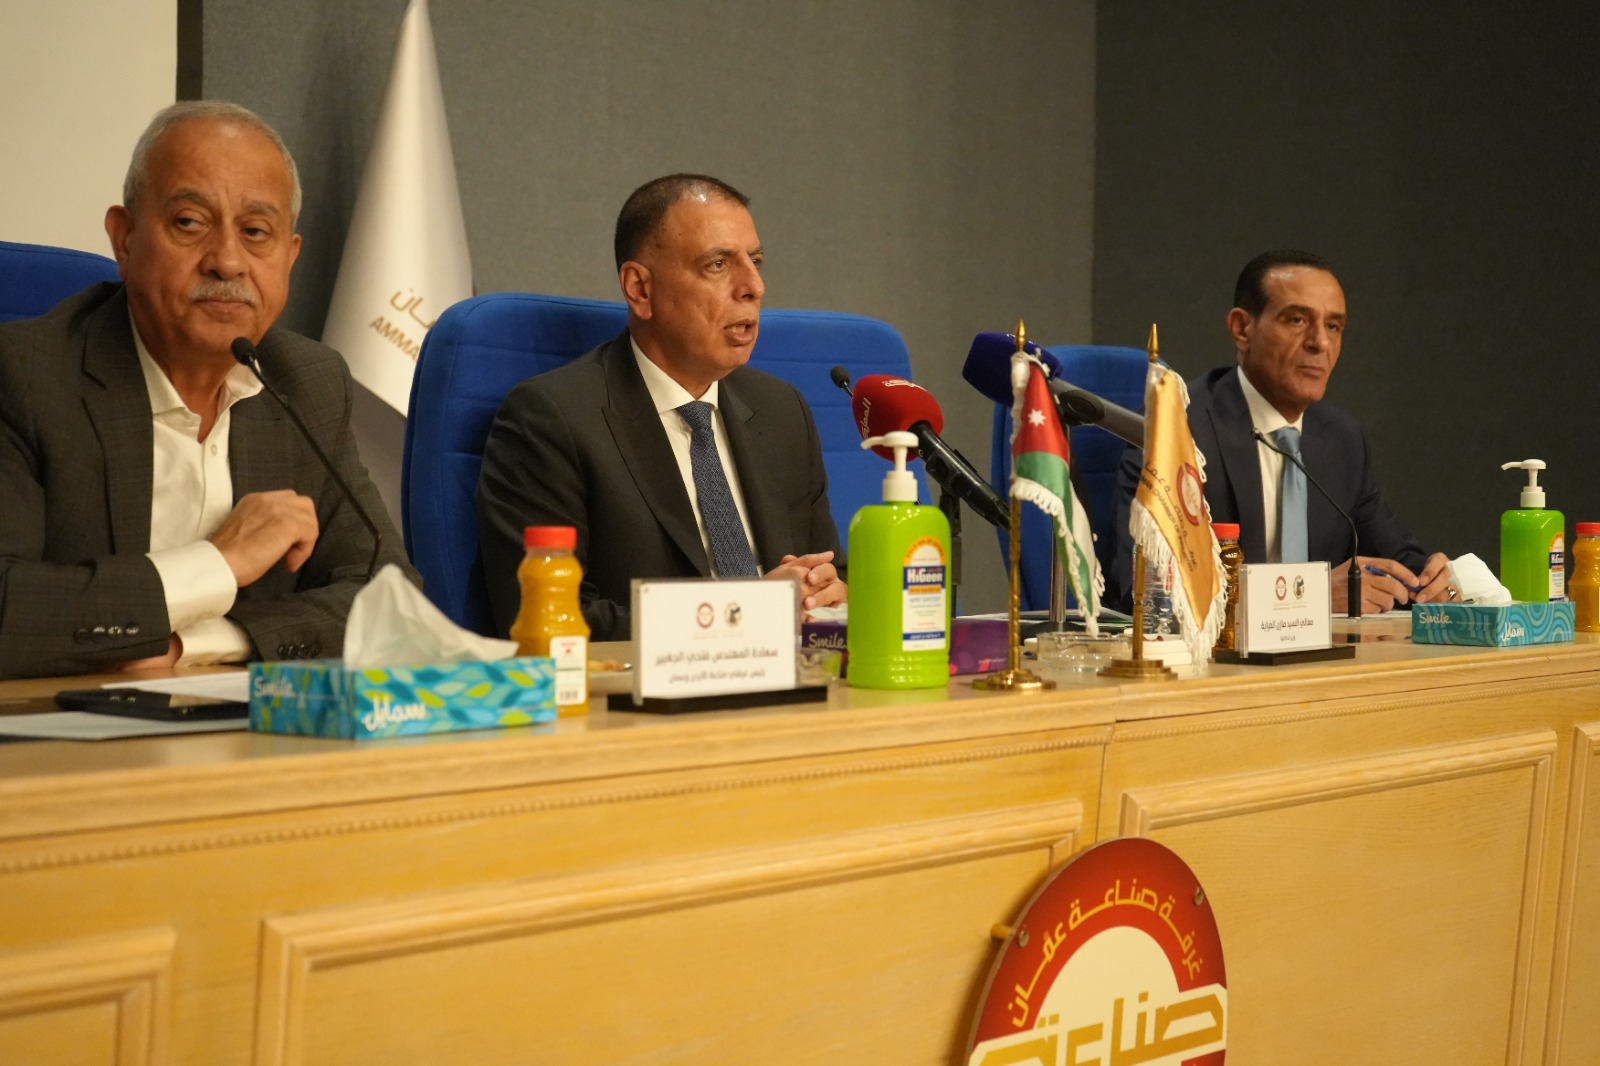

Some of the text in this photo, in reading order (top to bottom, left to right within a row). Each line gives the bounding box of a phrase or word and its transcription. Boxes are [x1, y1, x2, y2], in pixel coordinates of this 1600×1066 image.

[369, 317, 420, 361] AMMA
[1419, 611, 1453, 624] Smile
[808, 632, 846, 649] Smile
[253, 674, 296, 698] Smile
[1068, 878, 1158, 931] صناعة
[1158, 895, 1204, 981] غرفة
